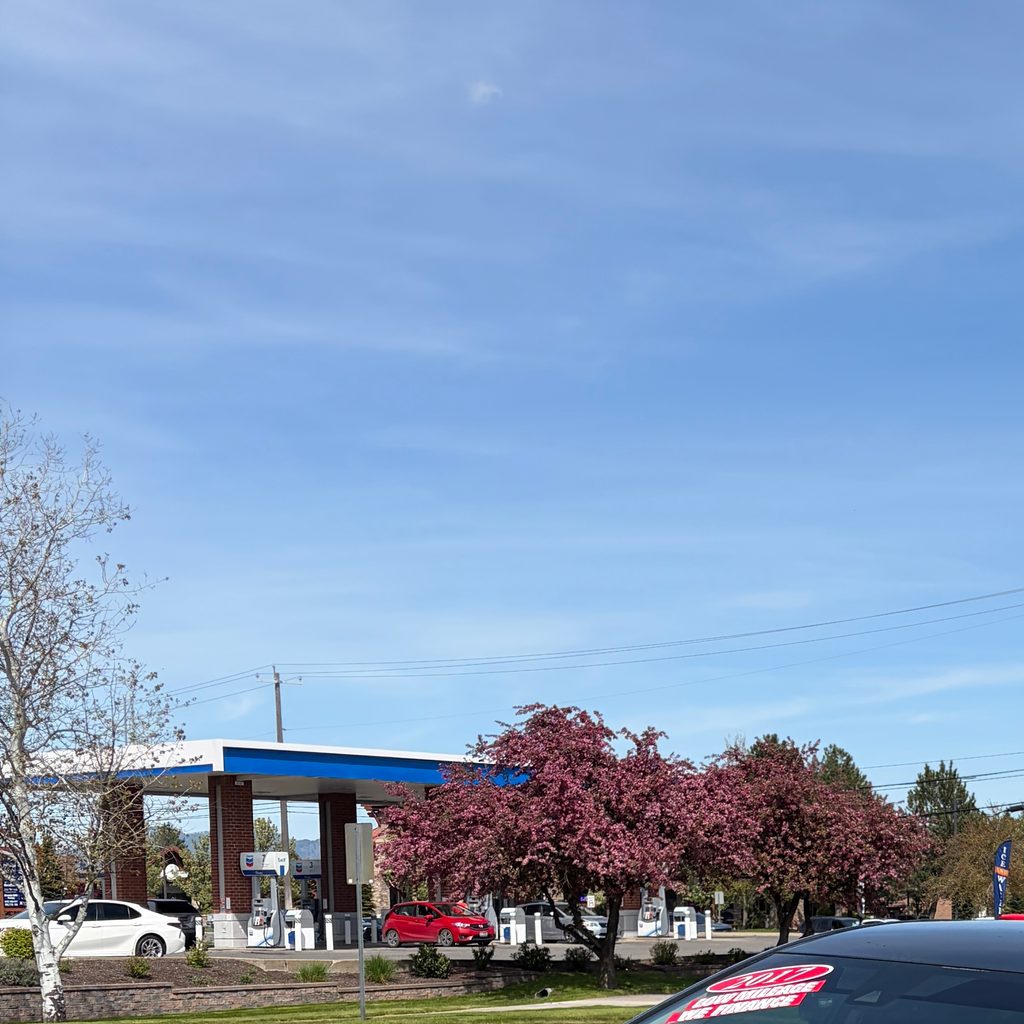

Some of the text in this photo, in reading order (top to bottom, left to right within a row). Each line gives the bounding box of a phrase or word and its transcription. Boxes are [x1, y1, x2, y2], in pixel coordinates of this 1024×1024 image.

[721, 966, 817, 990] 2017
[676, 994, 799, 1021] WE FINANCE
[691, 981, 819, 1008] LOW MILEAGE
